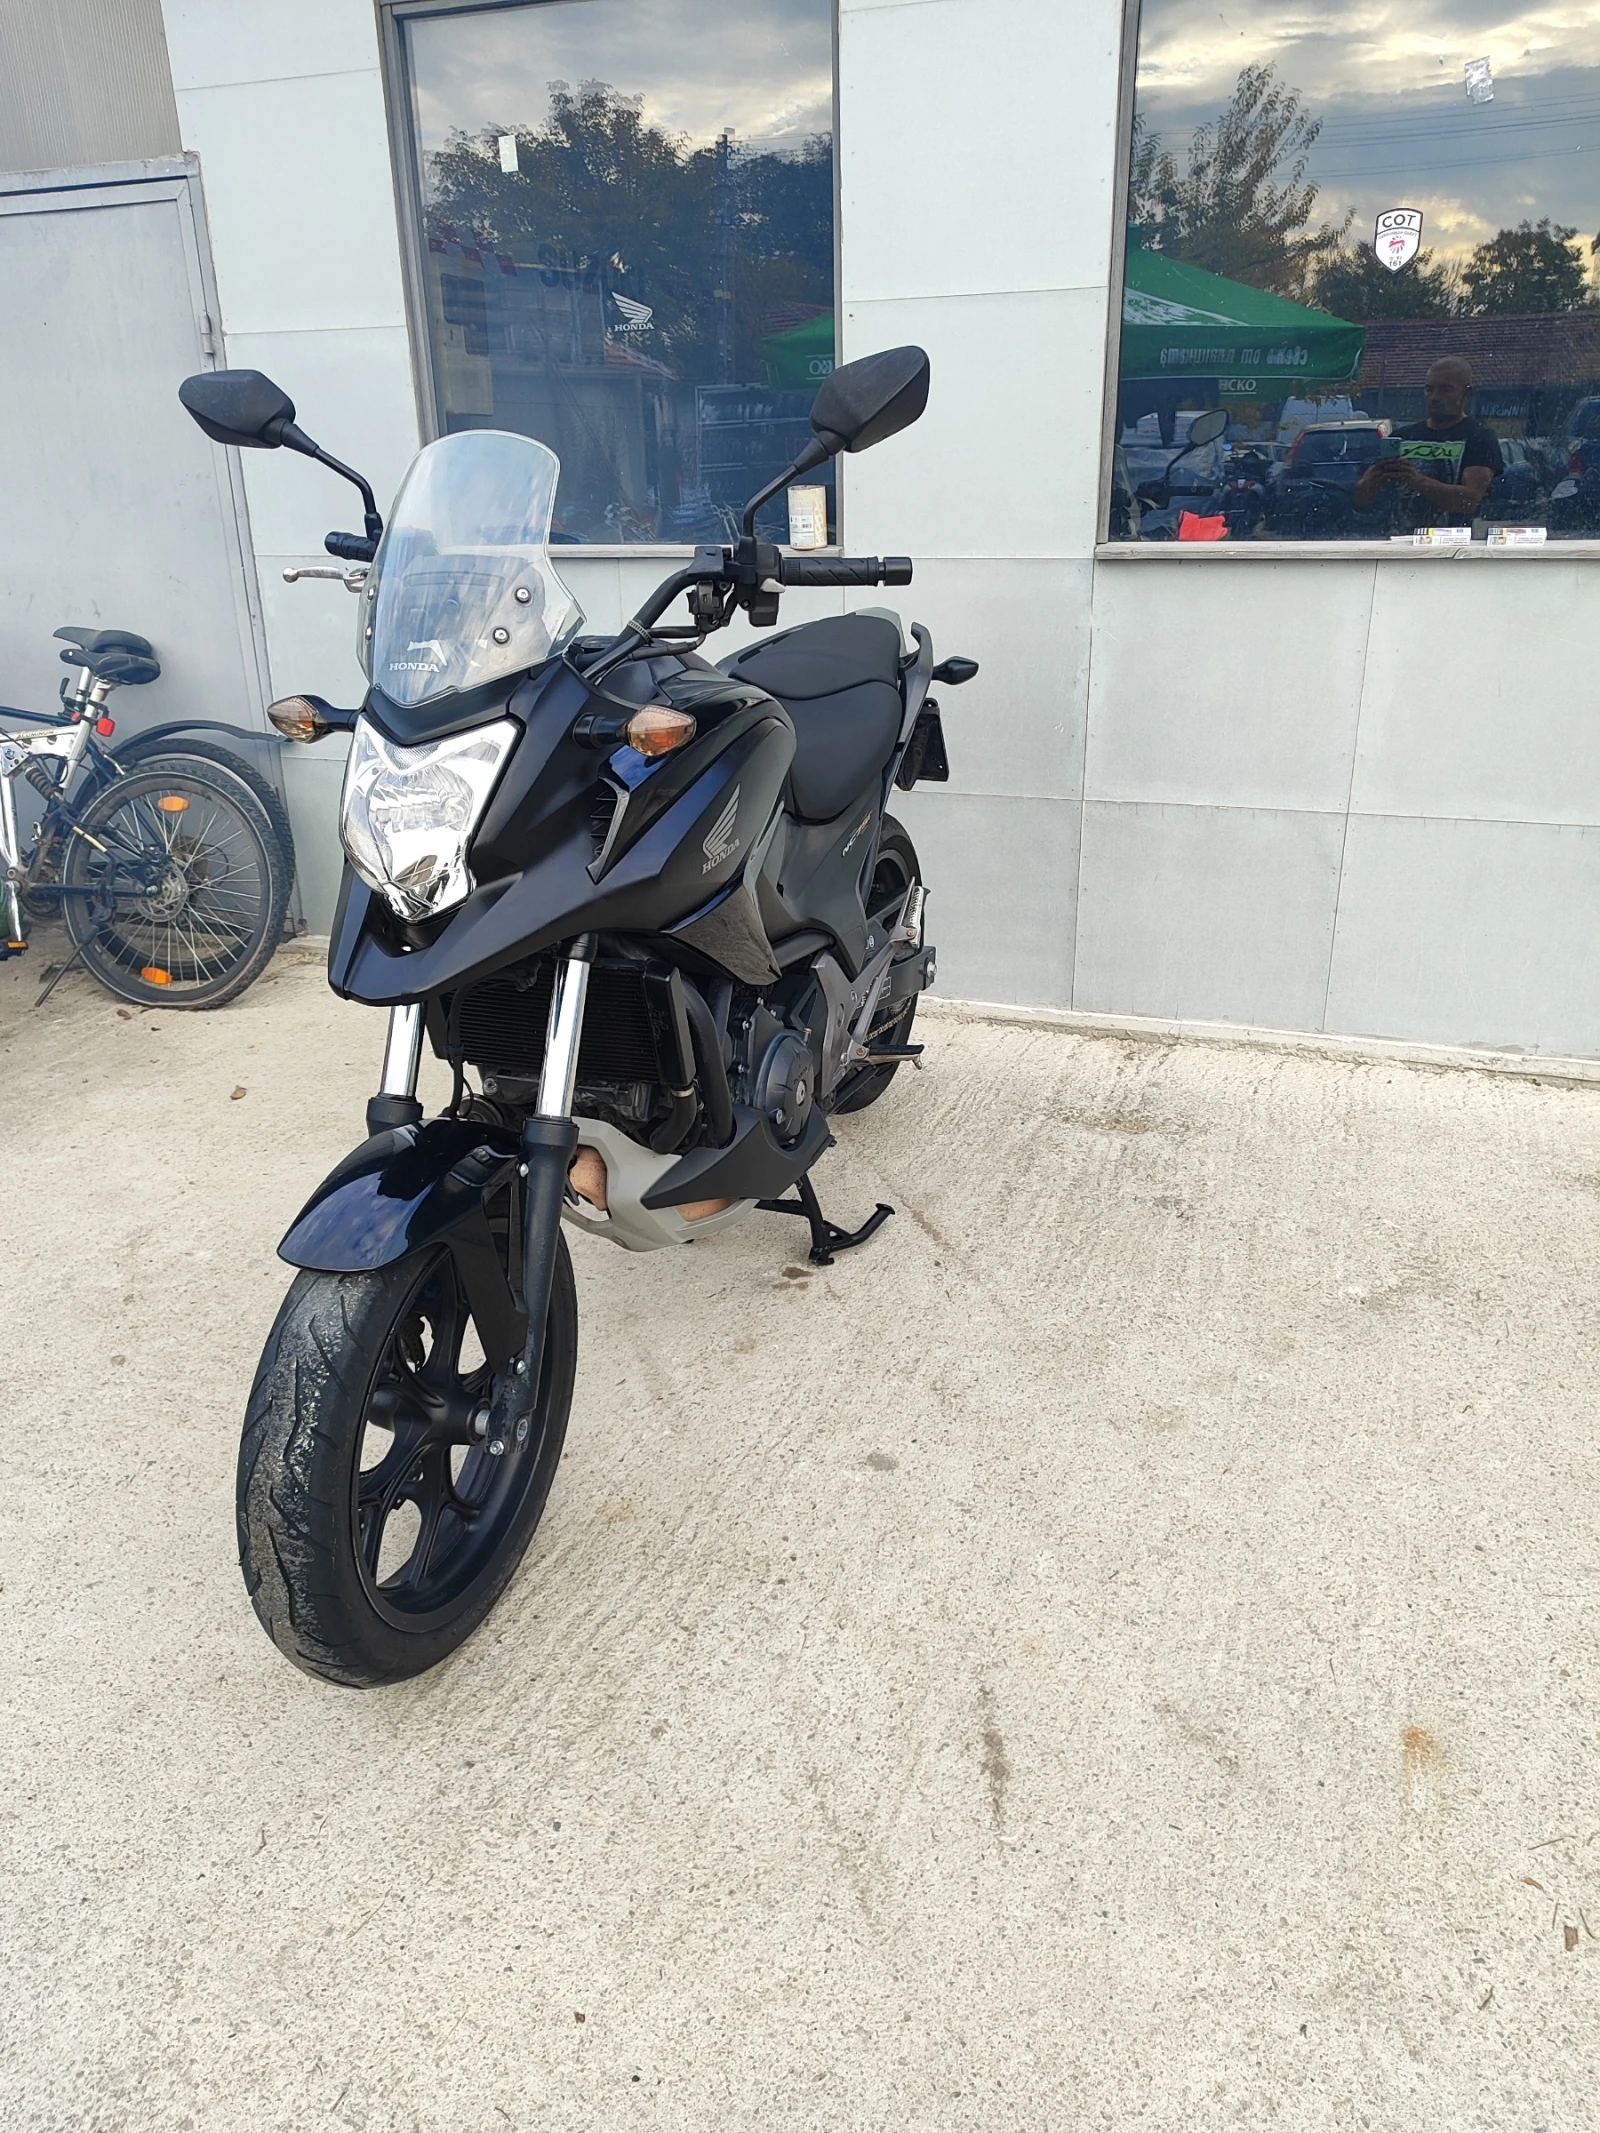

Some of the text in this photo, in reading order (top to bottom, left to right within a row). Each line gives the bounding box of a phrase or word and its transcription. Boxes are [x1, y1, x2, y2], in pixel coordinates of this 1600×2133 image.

[614, 322, 655, 332] HONDA
[389, 662, 441, 673] HONDA
[702, 838, 740, 875] HONDA
